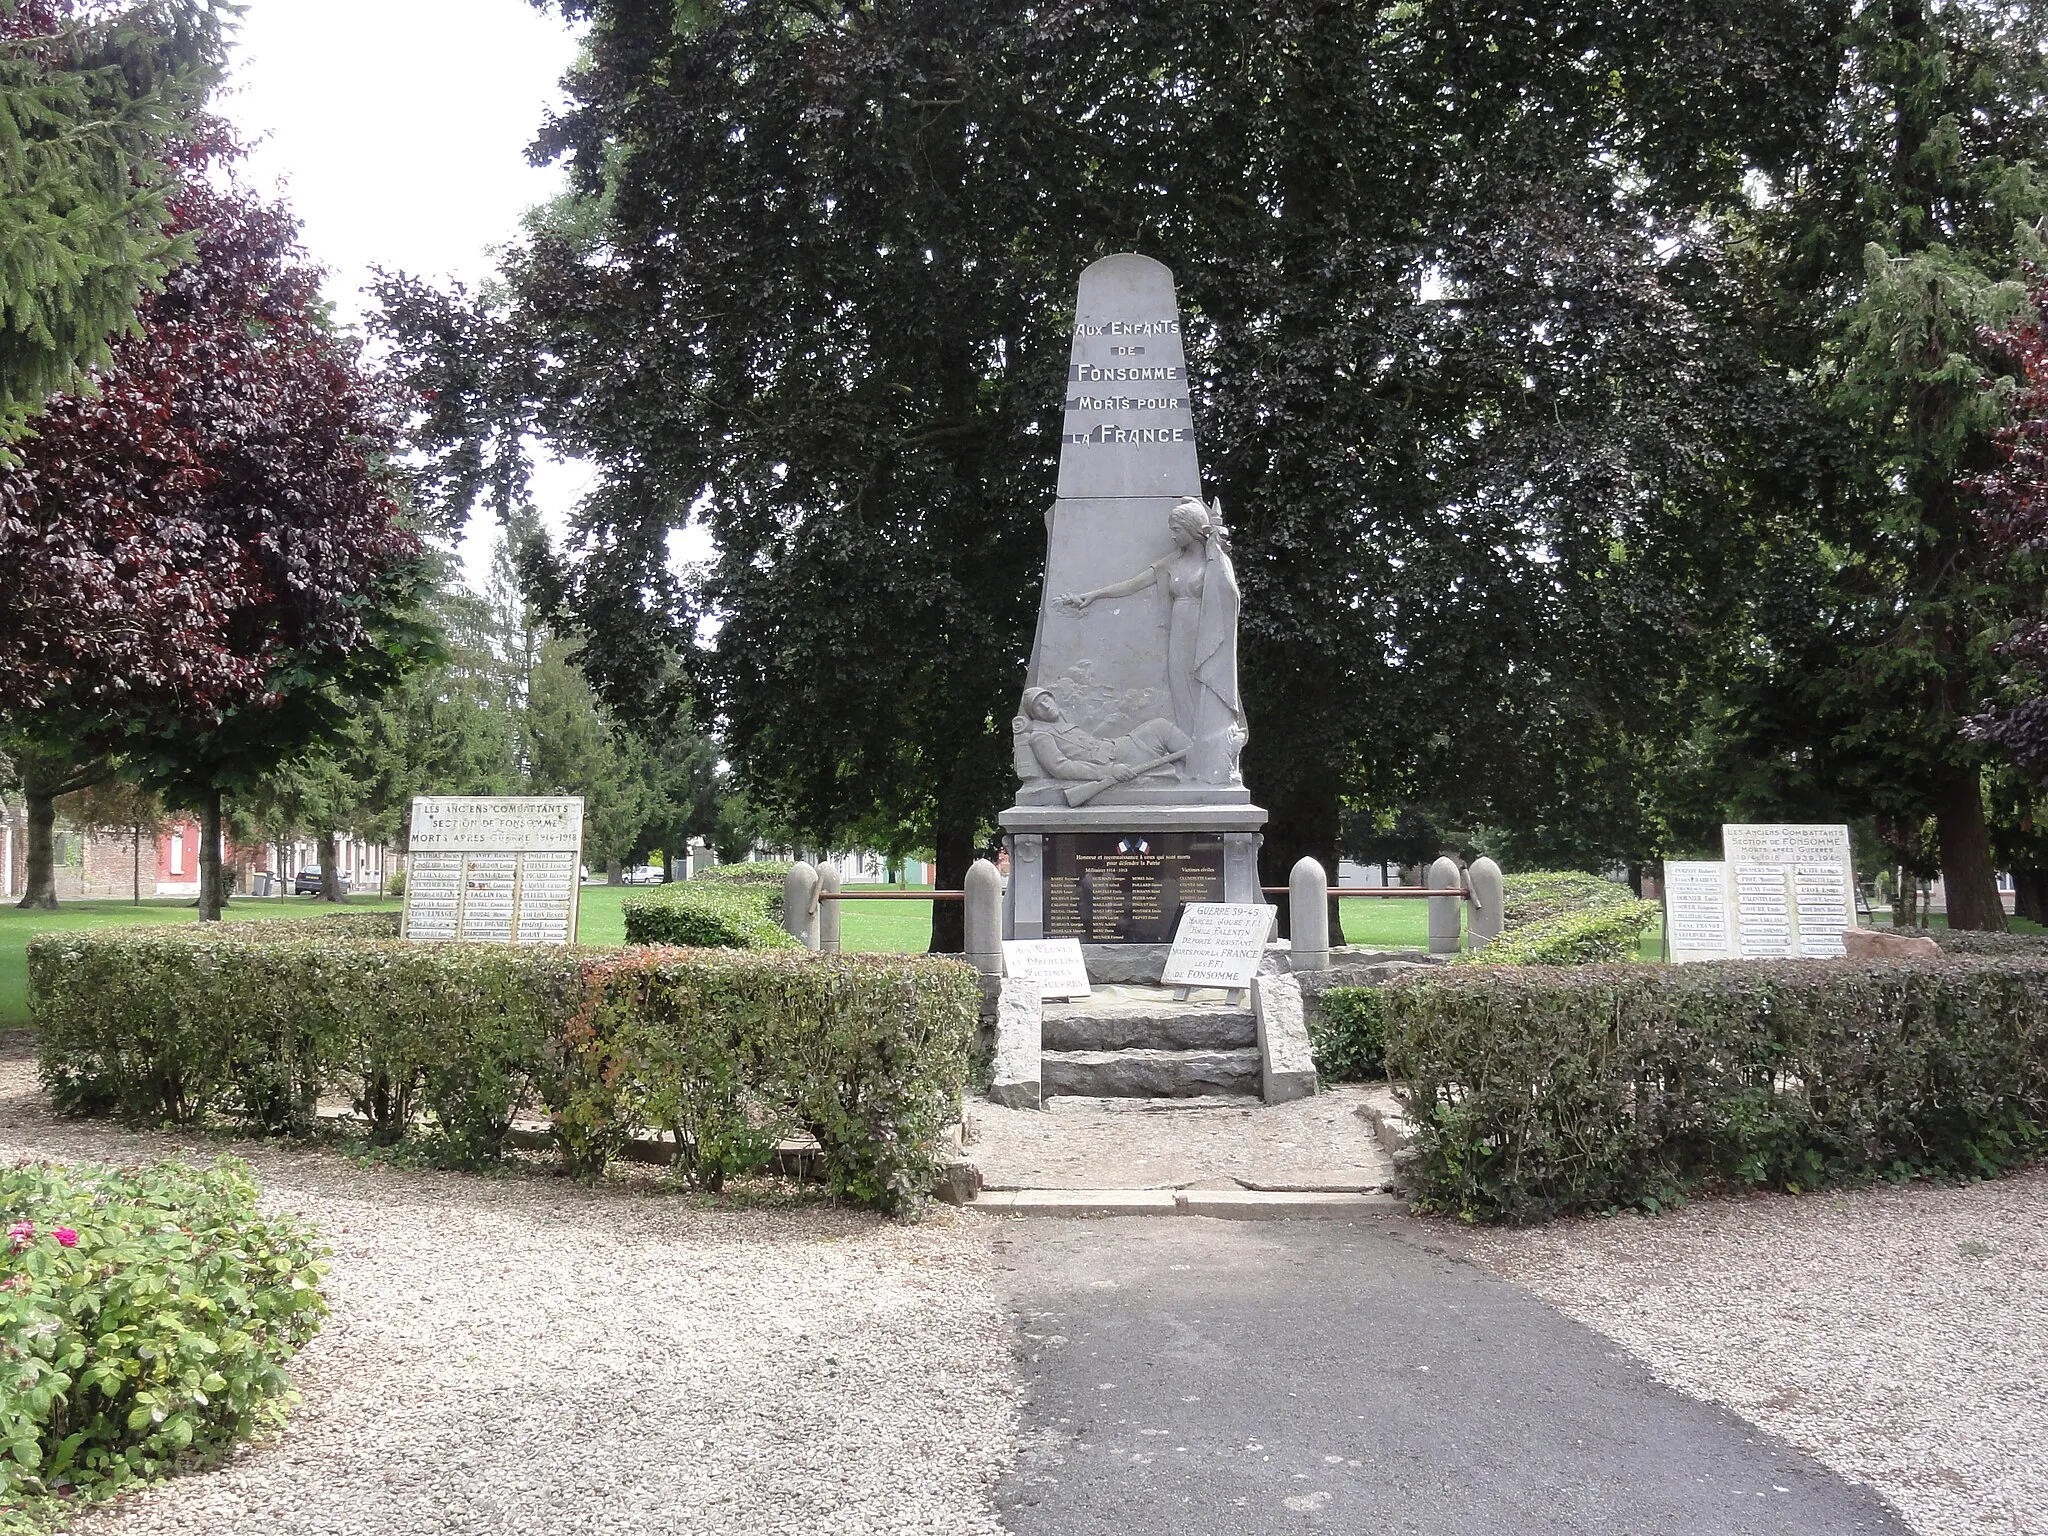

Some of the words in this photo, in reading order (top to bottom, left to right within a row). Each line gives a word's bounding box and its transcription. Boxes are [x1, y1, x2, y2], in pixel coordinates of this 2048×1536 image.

[1075, 323, 1103, 338] AUX
[1111, 320, 1179, 338] ENFANTS
[1118, 346, 1136, 355] DE
[1078, 363, 1177, 381] FONSOMME
[1079, 396, 1130, 410] MORTS
[1137, 398, 1178, 409] POUR
[1072, 433, 1090, 449] LA
[1101, 424, 1184, 451] FRANCE
[425, 805, 440, 813] LES
[1782, 838, 1841, 846] FONSOMME
[1196, 905, 1231, 916] GUERRE
[1220, 949, 1259, 959] FRANCE
[1186, 969, 1240, 981] FONSOMME
